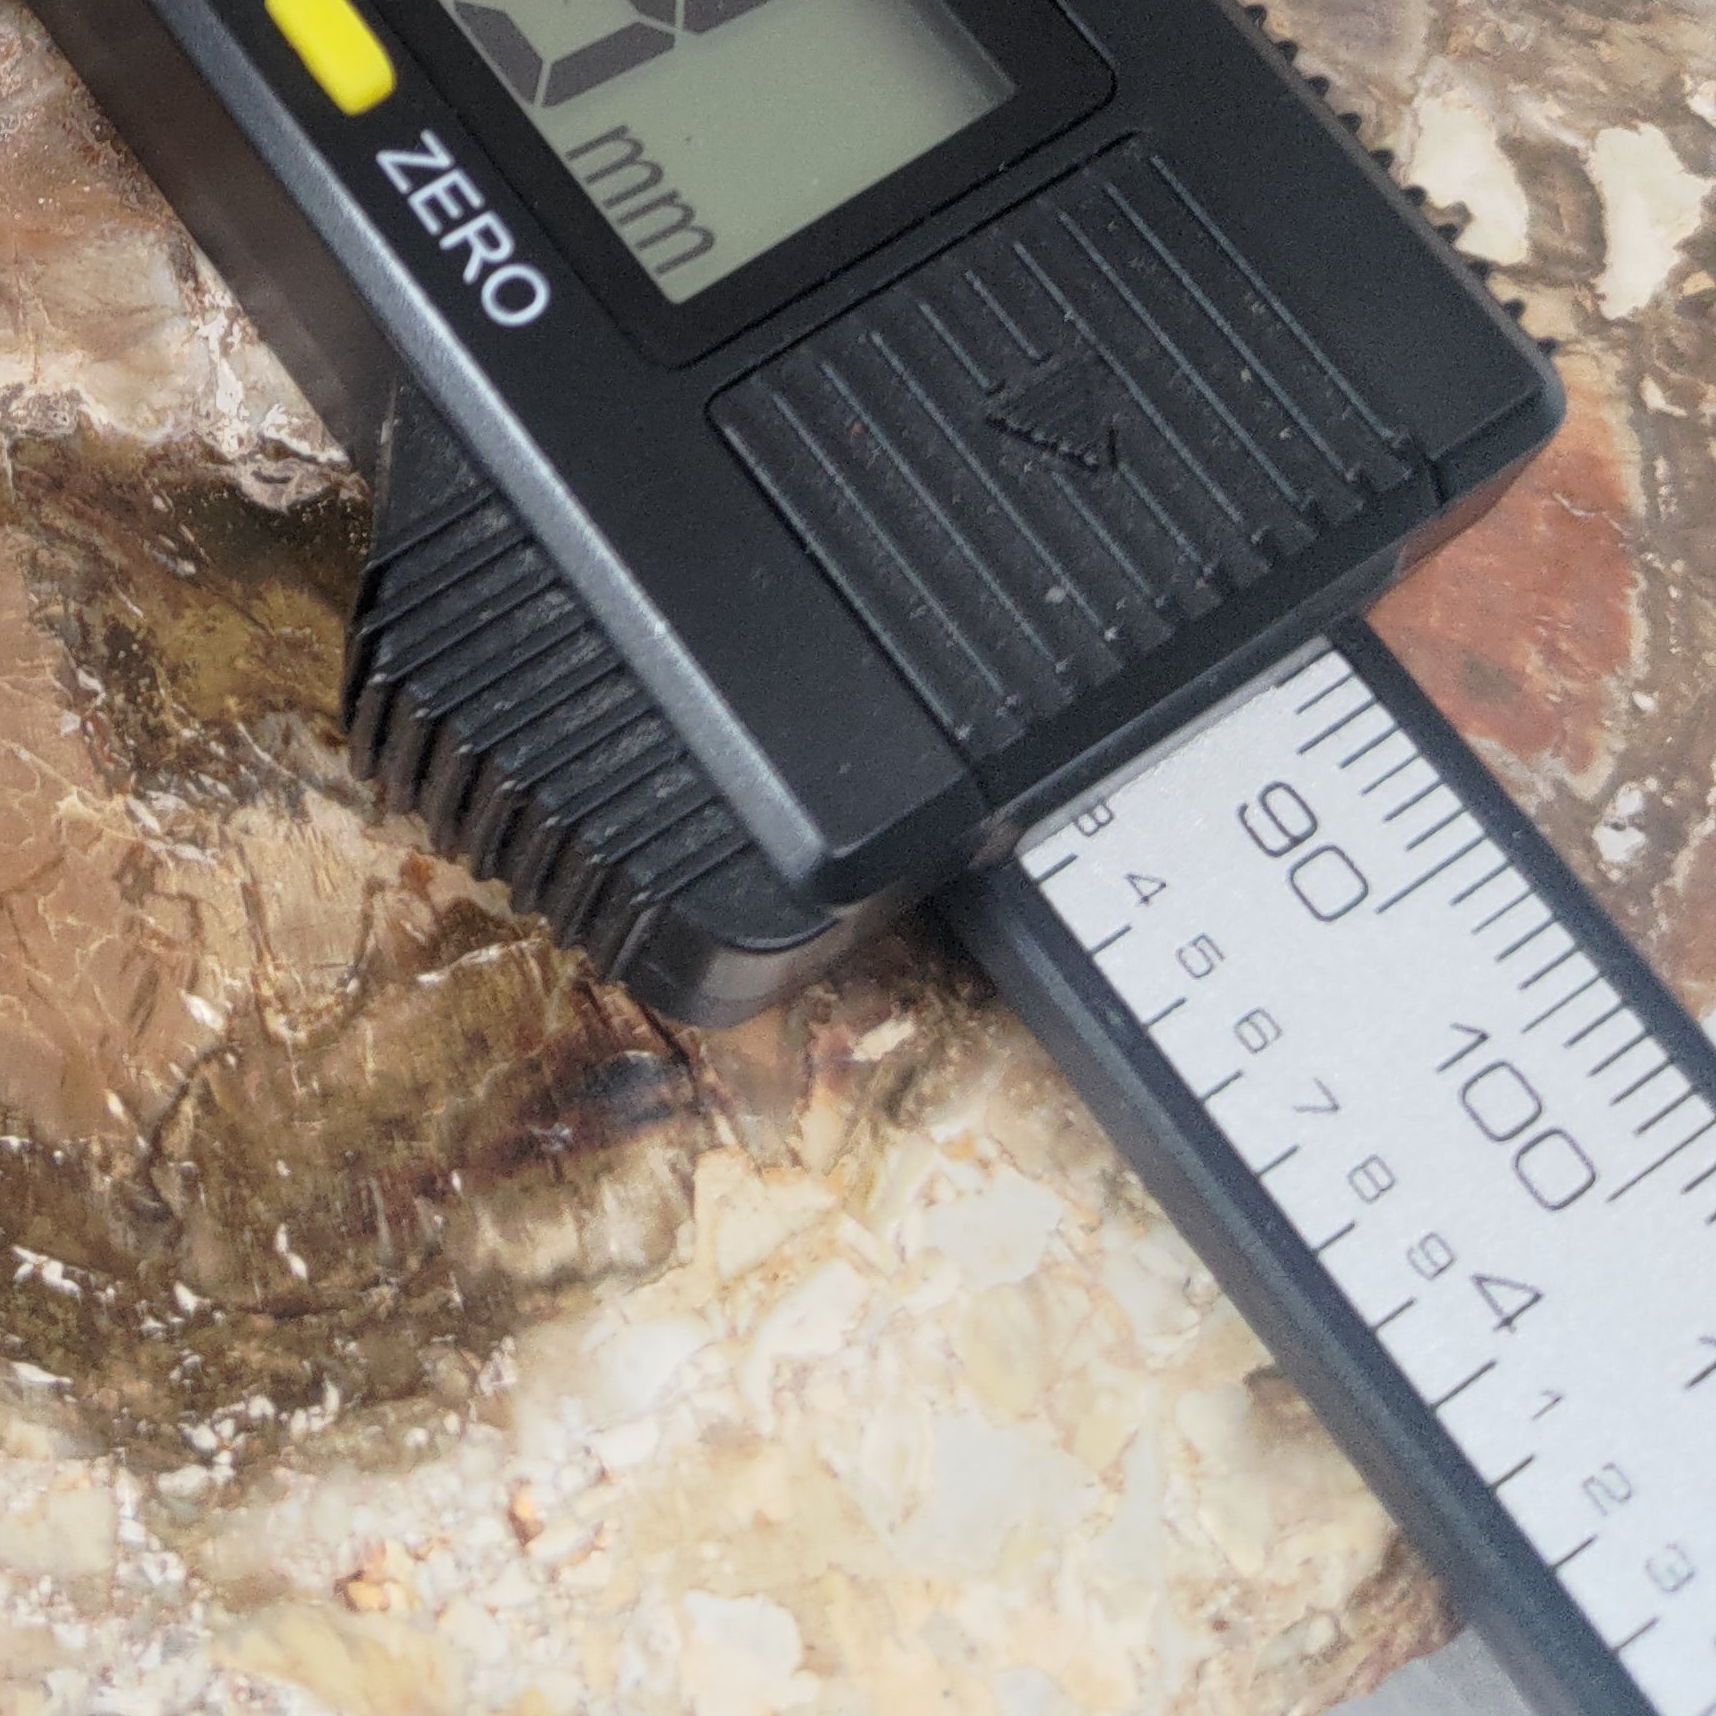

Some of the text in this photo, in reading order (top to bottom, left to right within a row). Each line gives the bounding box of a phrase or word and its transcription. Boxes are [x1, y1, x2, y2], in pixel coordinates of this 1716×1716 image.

[375, 129, 550, 326] ZERO
[567, 124, 717, 277] mm
[1236, 782, 1597, 1212] 90 100
[1125, 871, 1167, 904] 4
[1176, 934, 1226, 979] 5
[1234, 1009, 1283, 1054] 6
[1294, 1079, 1341, 1118] 7
[1347, 1155, 1396, 1204] 8
[1406, 1232, 1456, 1281] 9
[1471, 1273, 1544, 1333] 4
[1532, 1389, 1565, 1420] 1
[1584, 1463, 1634, 1516] 2
